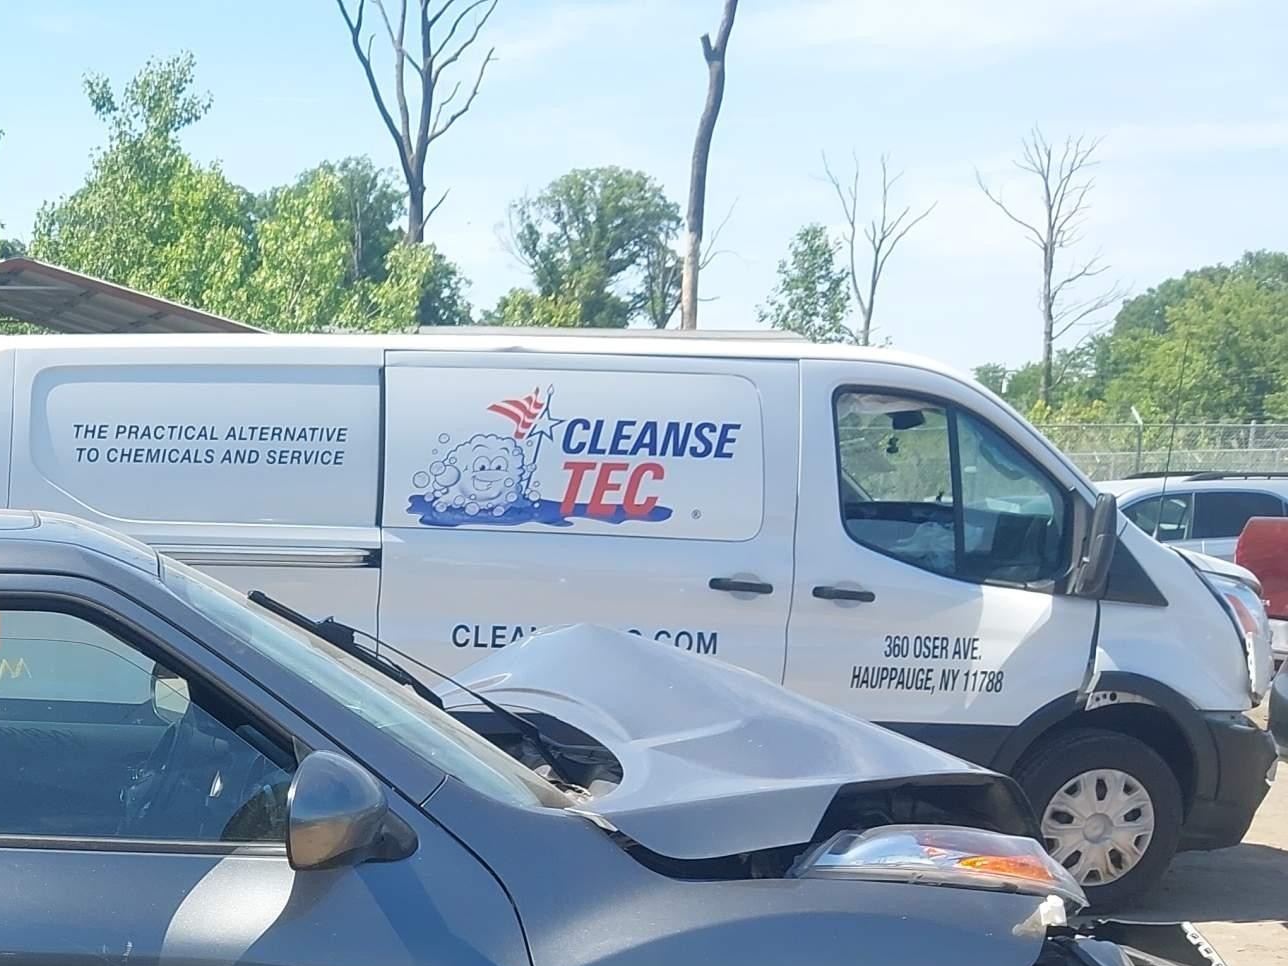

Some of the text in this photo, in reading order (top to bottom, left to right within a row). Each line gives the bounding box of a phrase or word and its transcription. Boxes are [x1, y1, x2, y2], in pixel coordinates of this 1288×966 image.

[73, 424, 348, 443] THE PRACTICAL ALTERNATIVE
[562, 418, 741, 458] CLEANSE
[75, 448, 344, 466] TO CHEMICALS AND SERVICE
[560, 462, 665, 516] TEC
[884, 635, 982, 660] 360 OSER AVE.
[850, 666, 1004, 695] HAUPPAUGE, NY 11788
